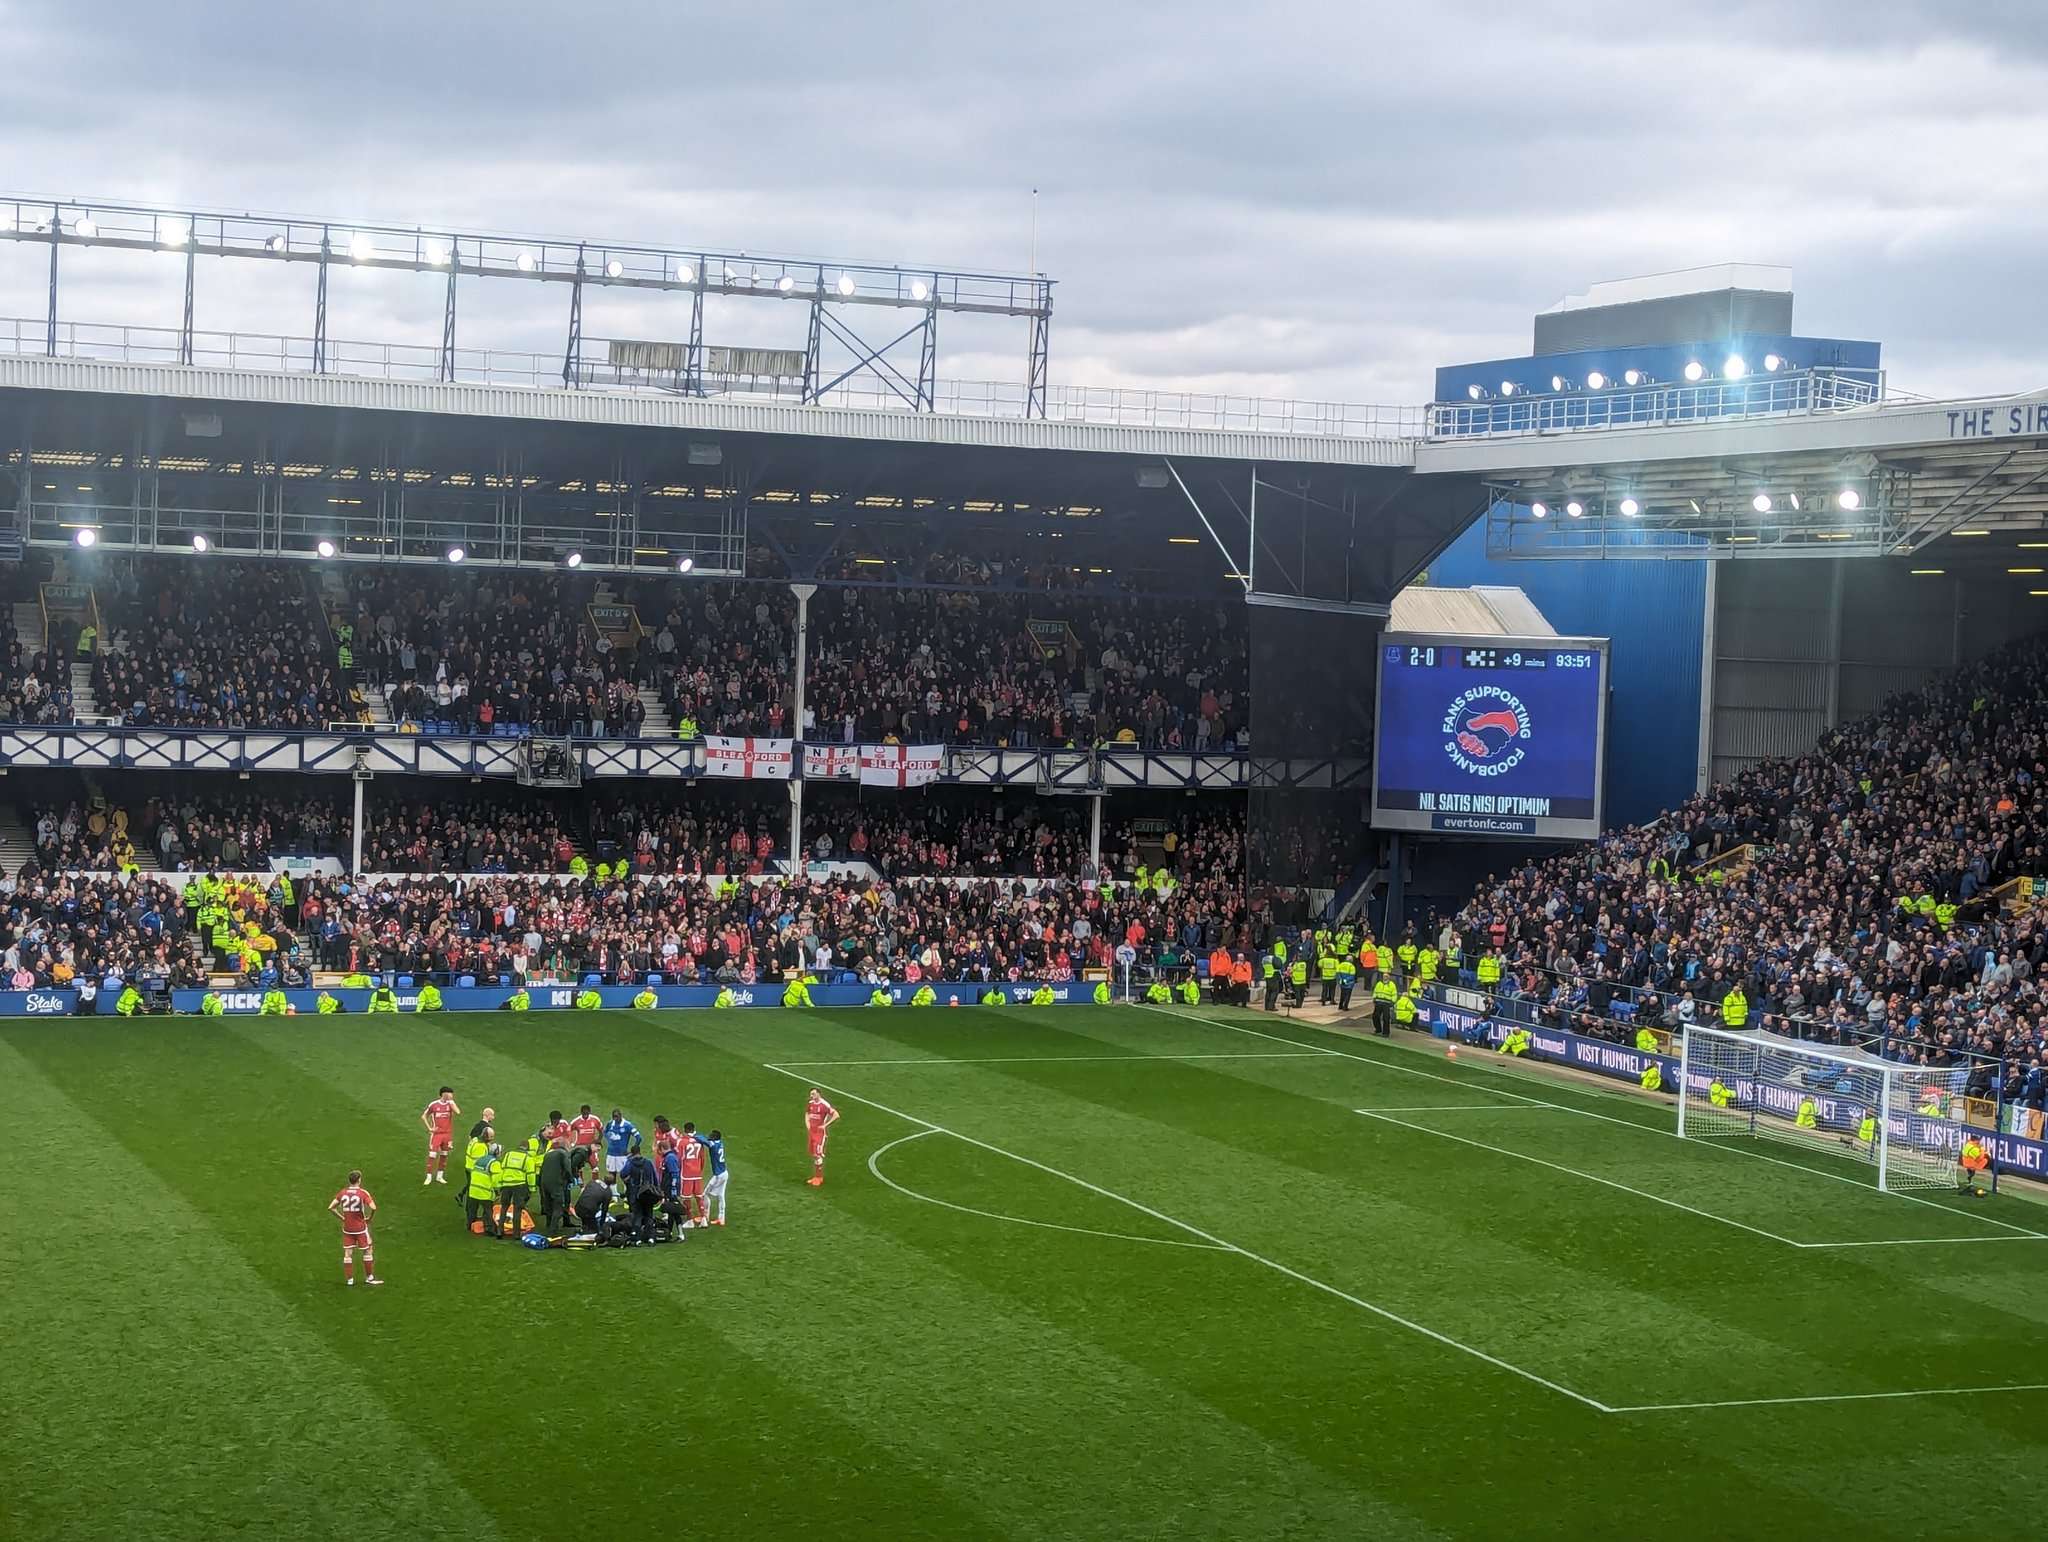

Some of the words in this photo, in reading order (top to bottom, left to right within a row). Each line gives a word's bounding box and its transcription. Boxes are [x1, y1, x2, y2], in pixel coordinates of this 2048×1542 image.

[1947, 409, 1994, 438] THE
[2009, 405, 2048, 434] SIR
[1410, 647, 1434, 666] 2-0
[1556, 655, 1591, 668] 93:51
[1443, 697, 1466, 733] FANS
[1465, 686, 1532, 739] SUPPORTING
[721, 738, 730, 747] N
[770, 741, 777, 749] F
[813, 748, 821, 757] N
[1445, 741, 1526, 776] FOODBANKS
[722, 763, 728, 772] F
[767, 766, 776, 774] C
[812, 764, 820, 773] F
[840, 764, 848, 774] C
[871, 758, 933, 770] SLEAFORD
[1419, 792, 1437, 810] NIL
[1439, 793, 1471, 812] SATIS
[1472, 795, 1495, 813] NISI
[1497, 796, 1550, 816] OPTIMUM
[1444, 818, 1523, 831] evertonfc.com
[26, 994, 63, 1012] Stake
[732, 989, 753, 1004] take
[1533, 1033, 1566, 1055] hummel
[1576, 1041, 1601, 1066] VISIT
[1923, 1122, 1957, 1149] VISIT
[686, 1143, 701, 1158] 27
[341, 1195, 360, 1211] 22
